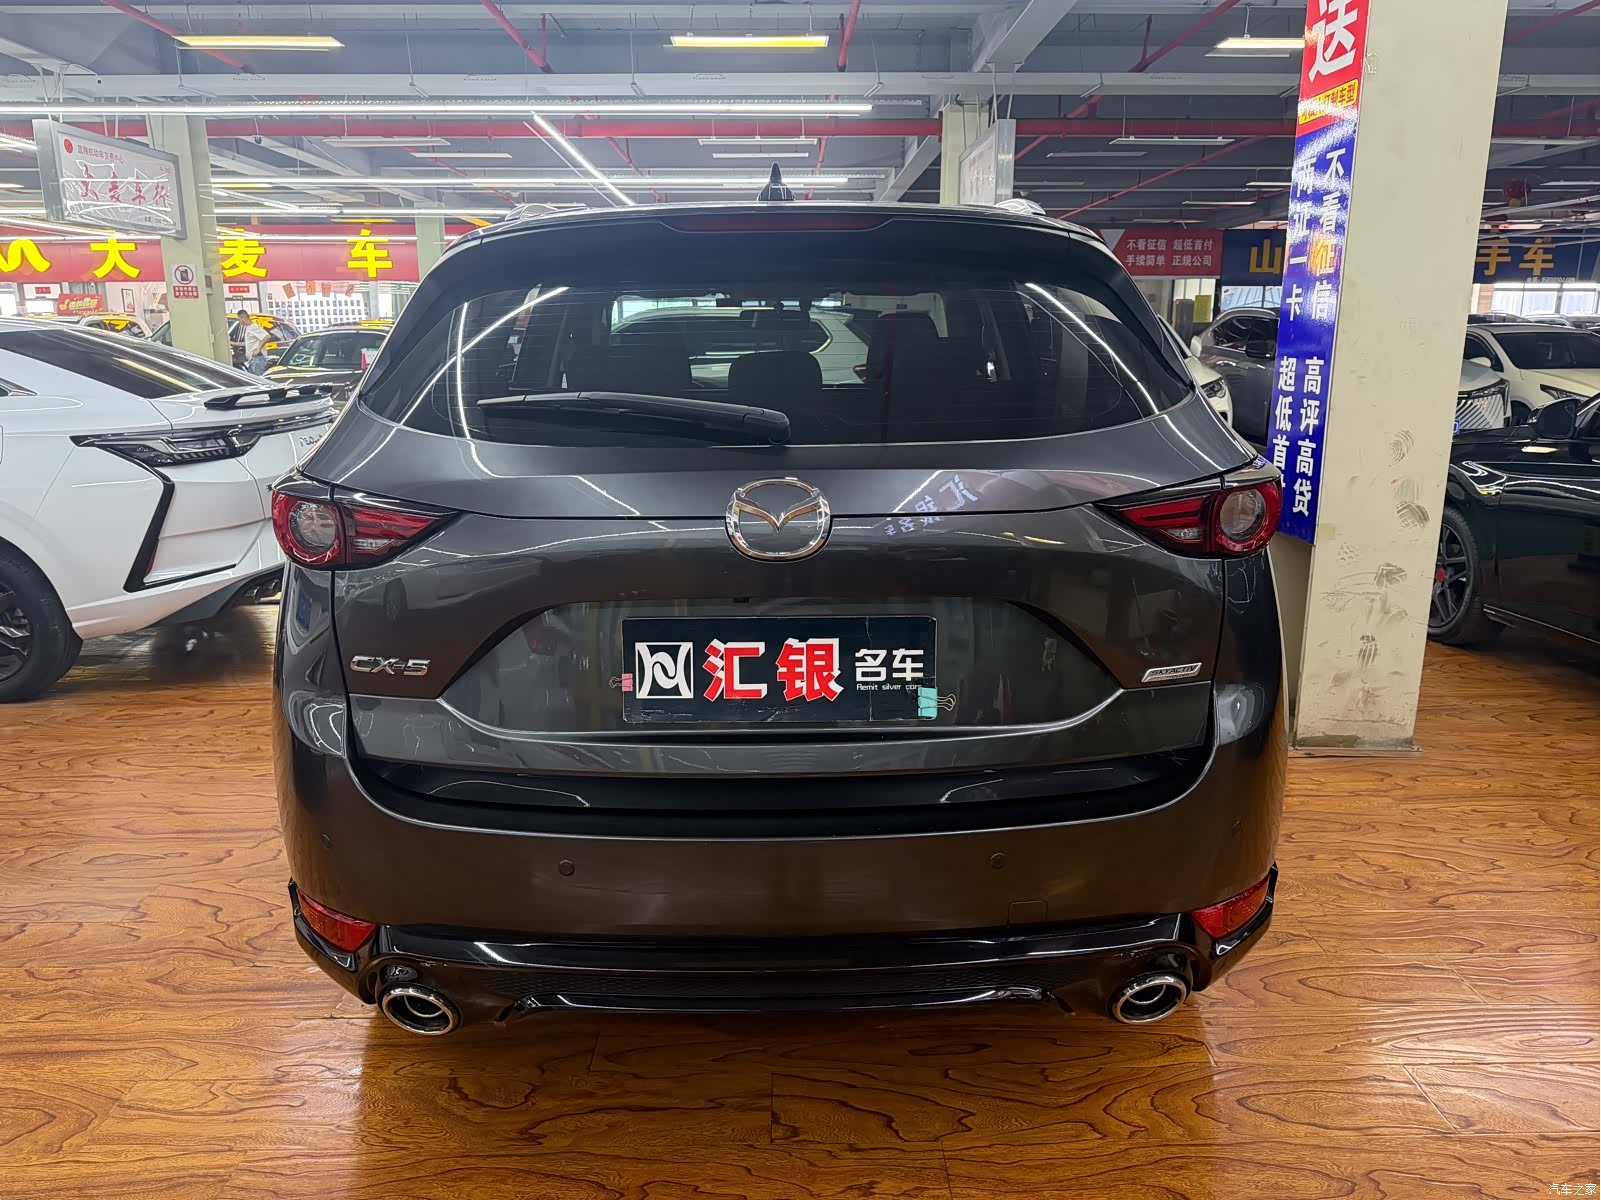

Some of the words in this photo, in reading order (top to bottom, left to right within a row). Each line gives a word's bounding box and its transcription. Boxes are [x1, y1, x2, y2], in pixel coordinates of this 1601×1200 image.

[1308, 0, 1358, 84] 送
[1301, 81, 1356, 121] 订制车型
[1126, 239, 1167, 251] 不看征信
[1173, 239, 1214, 251] 超低首付
[1250, 239, 1282, 274] 山
[1286, 156, 1316, 321] 两证一卡
[1311, 148, 1347, 320] 不看征信
[1125, 255, 1166, 267] 手续简单
[1172, 255, 1212, 267] 正规公司
[1273, 356, 1297, 487] 超低首
[1293, 356, 1324, 517] 高评高贷
[350, 655, 431, 676] CX-5
[702, 637, 845, 702] 汇银
[854, 648, 925, 682] 名车
[857, 683, 878, 691] Remit
[881, 682, 902, 690] silver
